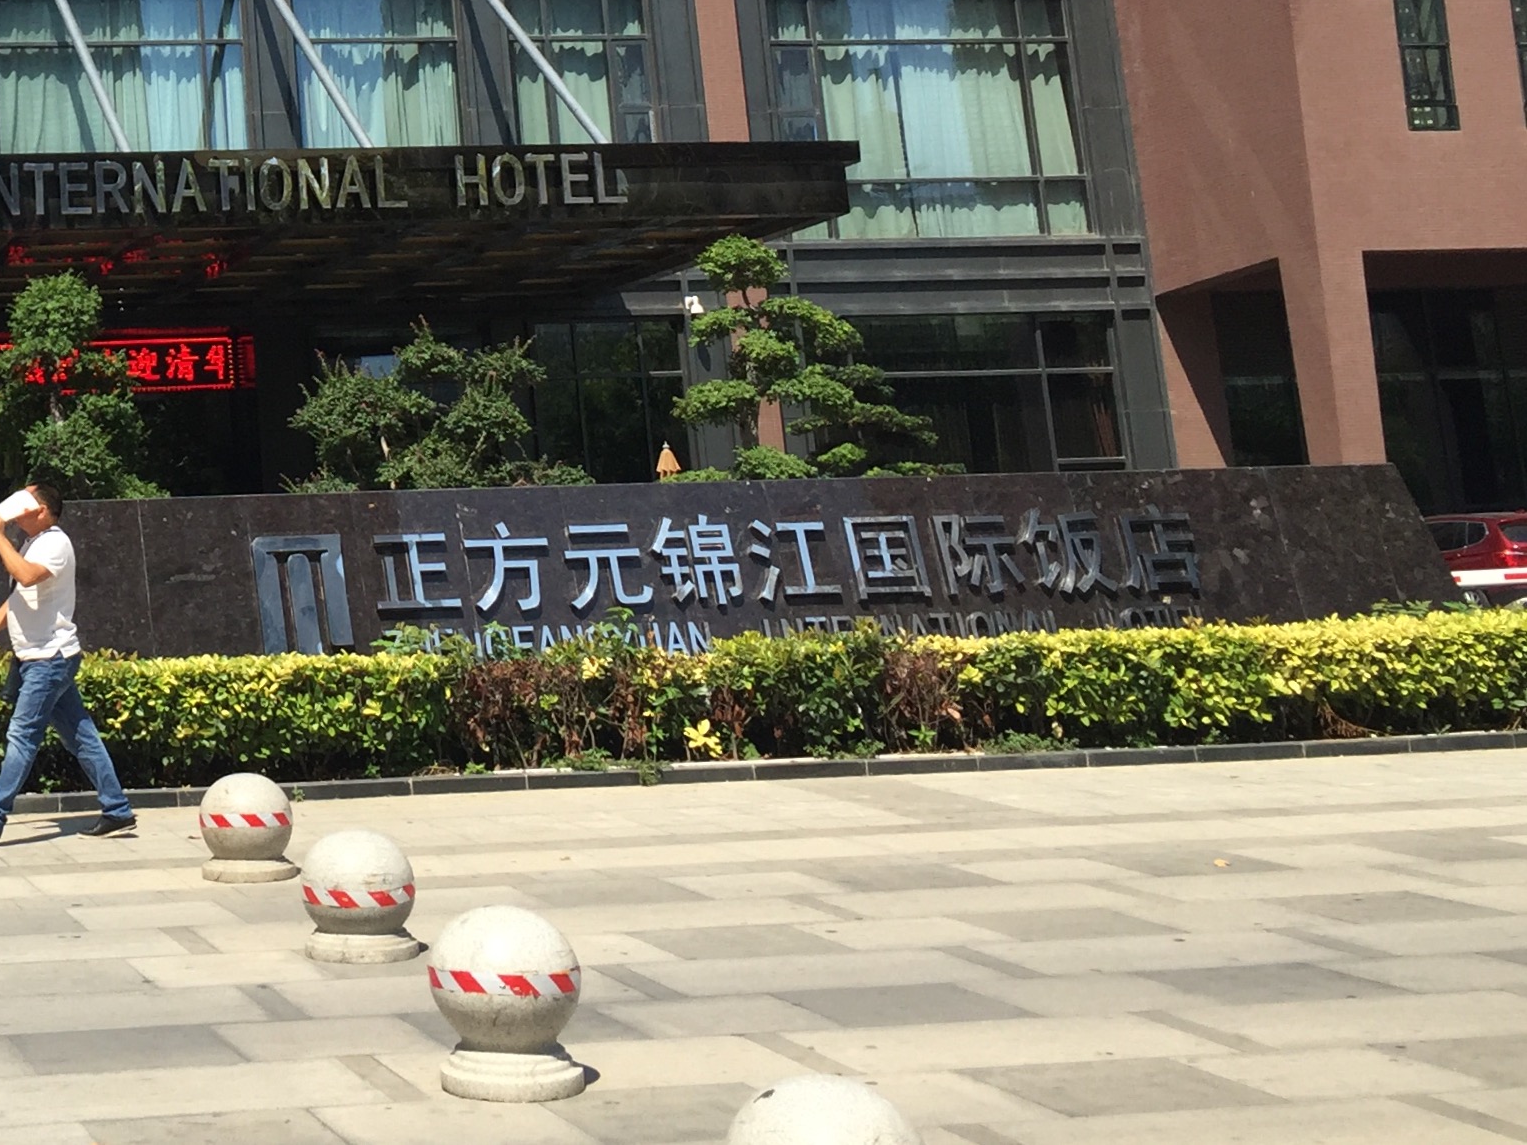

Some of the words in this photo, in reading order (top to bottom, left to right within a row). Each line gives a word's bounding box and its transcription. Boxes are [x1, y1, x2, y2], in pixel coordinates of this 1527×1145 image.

[454, 151, 629, 206] HOTEL
[373, 504, 1200, 611] 正方元锦江国际饭店
